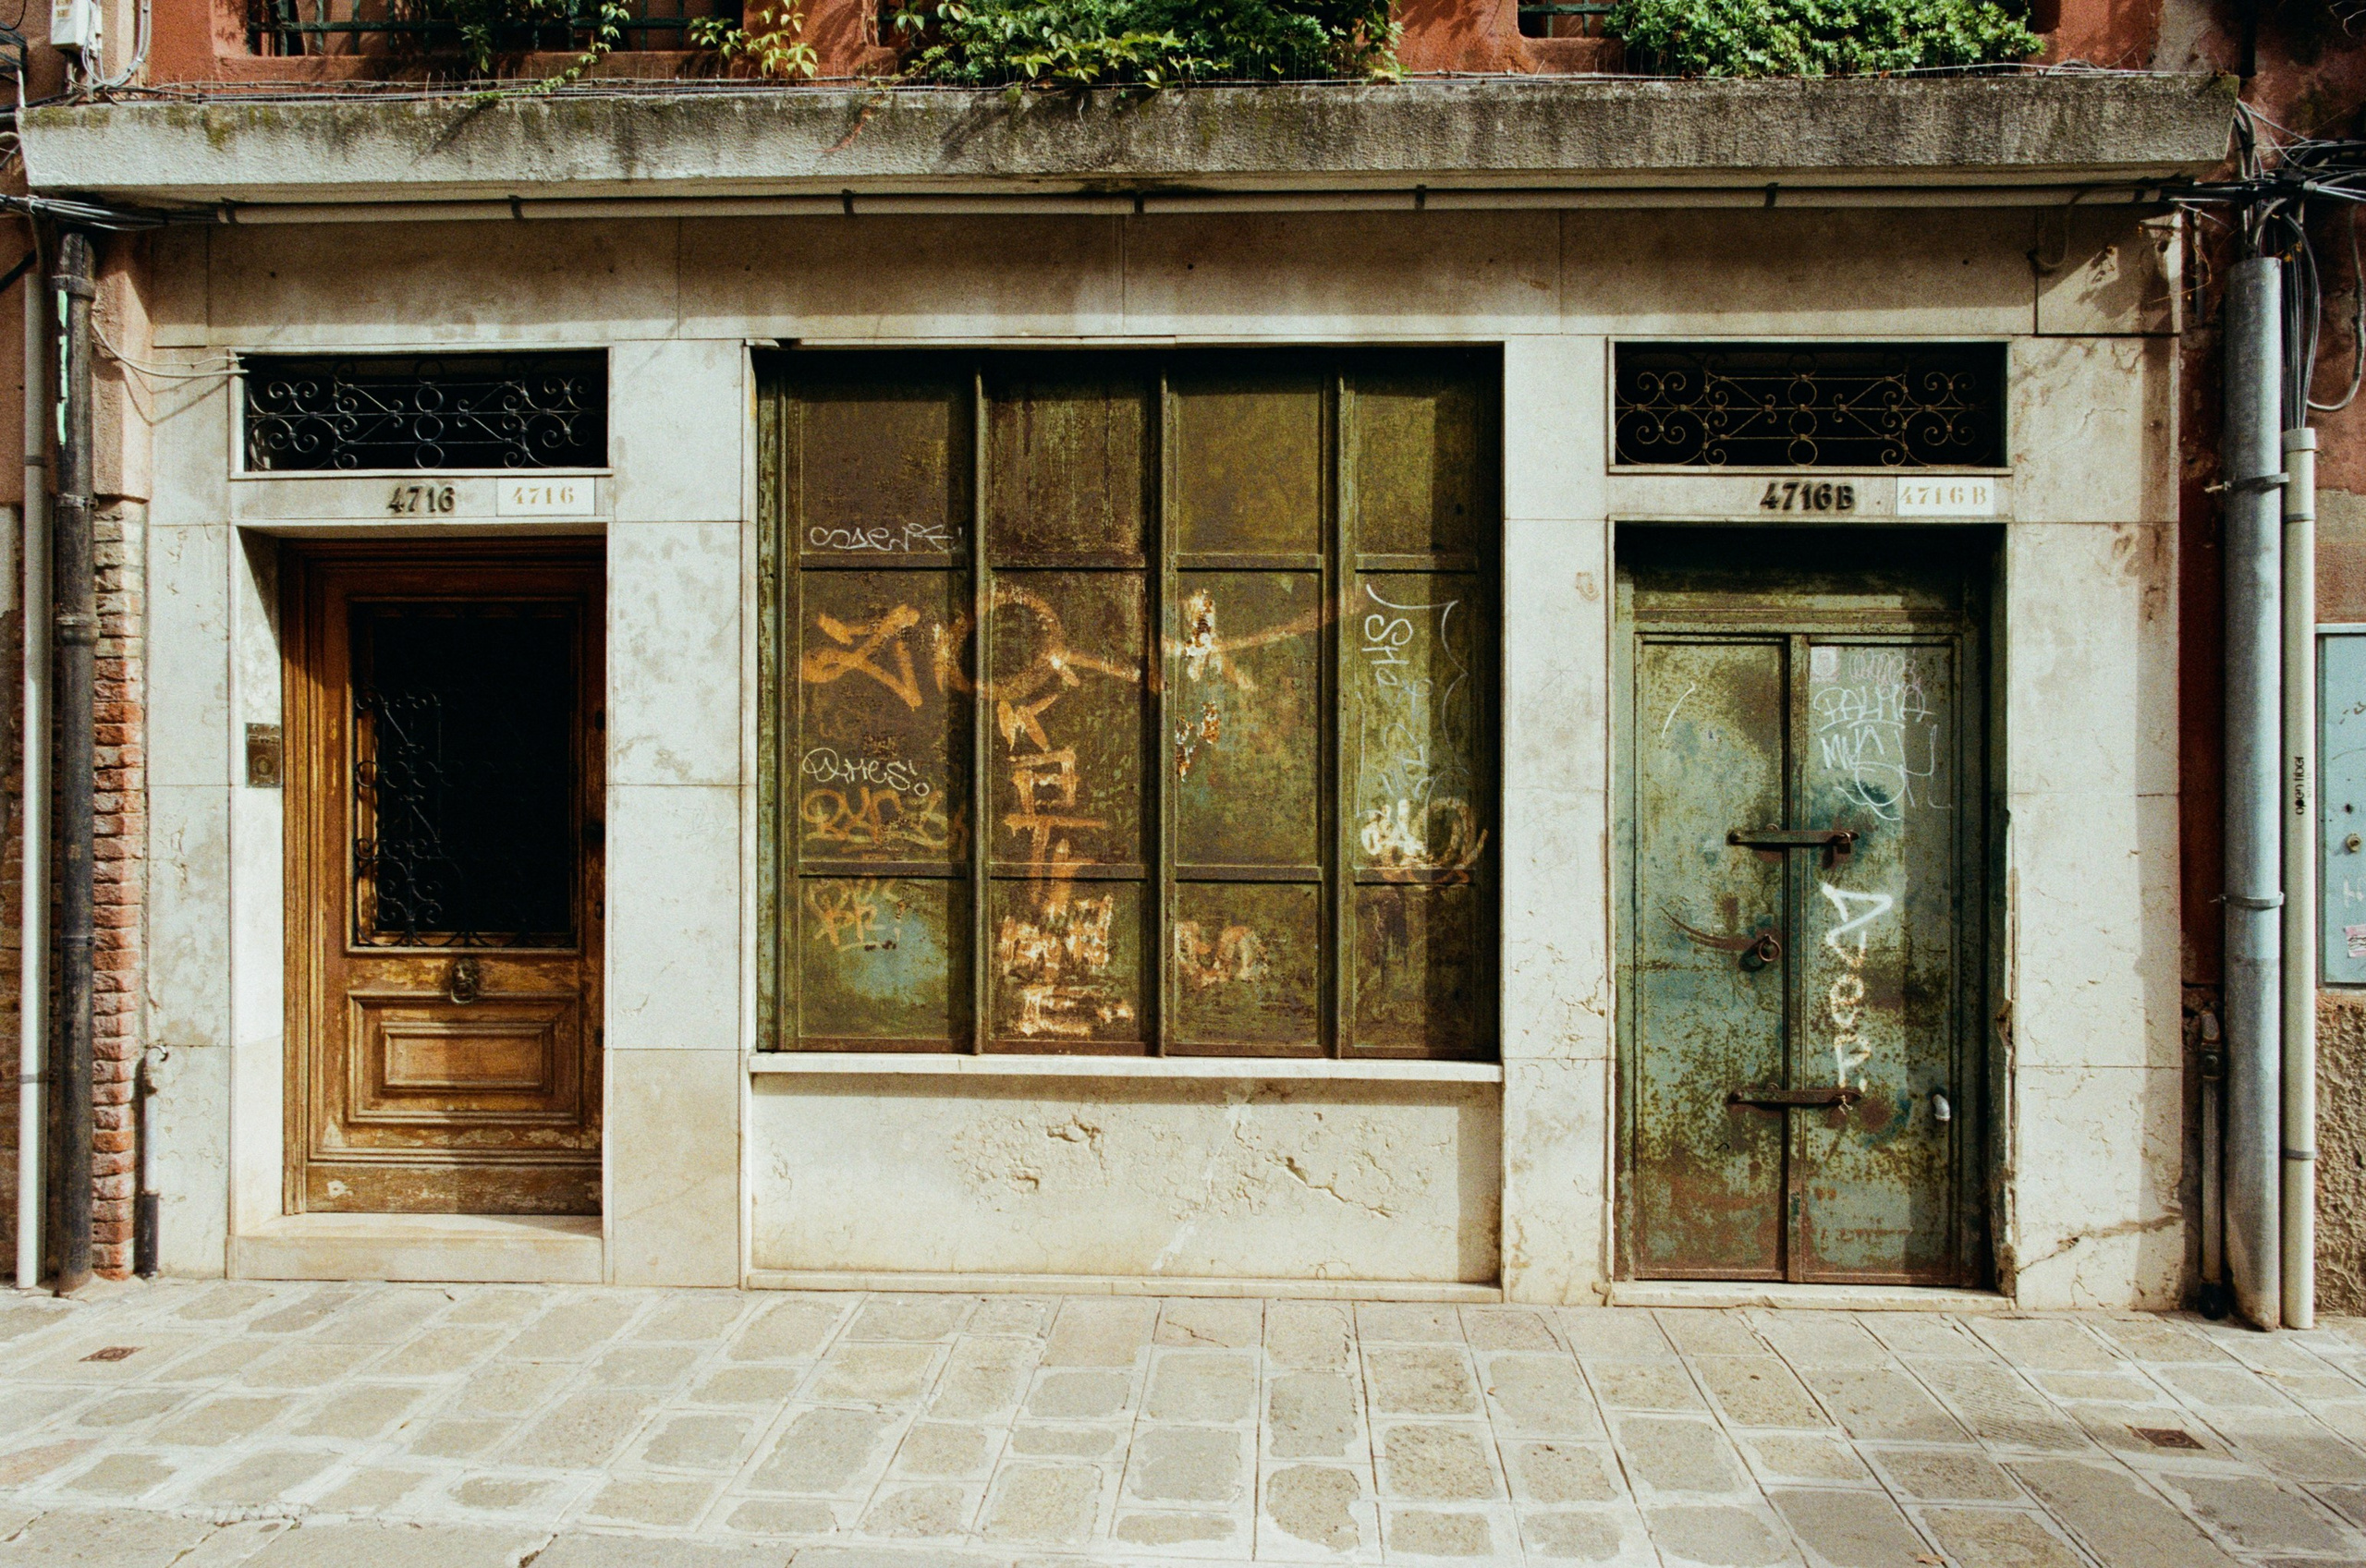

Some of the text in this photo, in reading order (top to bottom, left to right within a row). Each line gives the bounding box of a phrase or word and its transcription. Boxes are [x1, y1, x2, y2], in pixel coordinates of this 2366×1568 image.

[387, 486, 456, 513] 4716
[512, 486, 575, 504] 4716
[1760, 481, 1855, 510] 4716B
